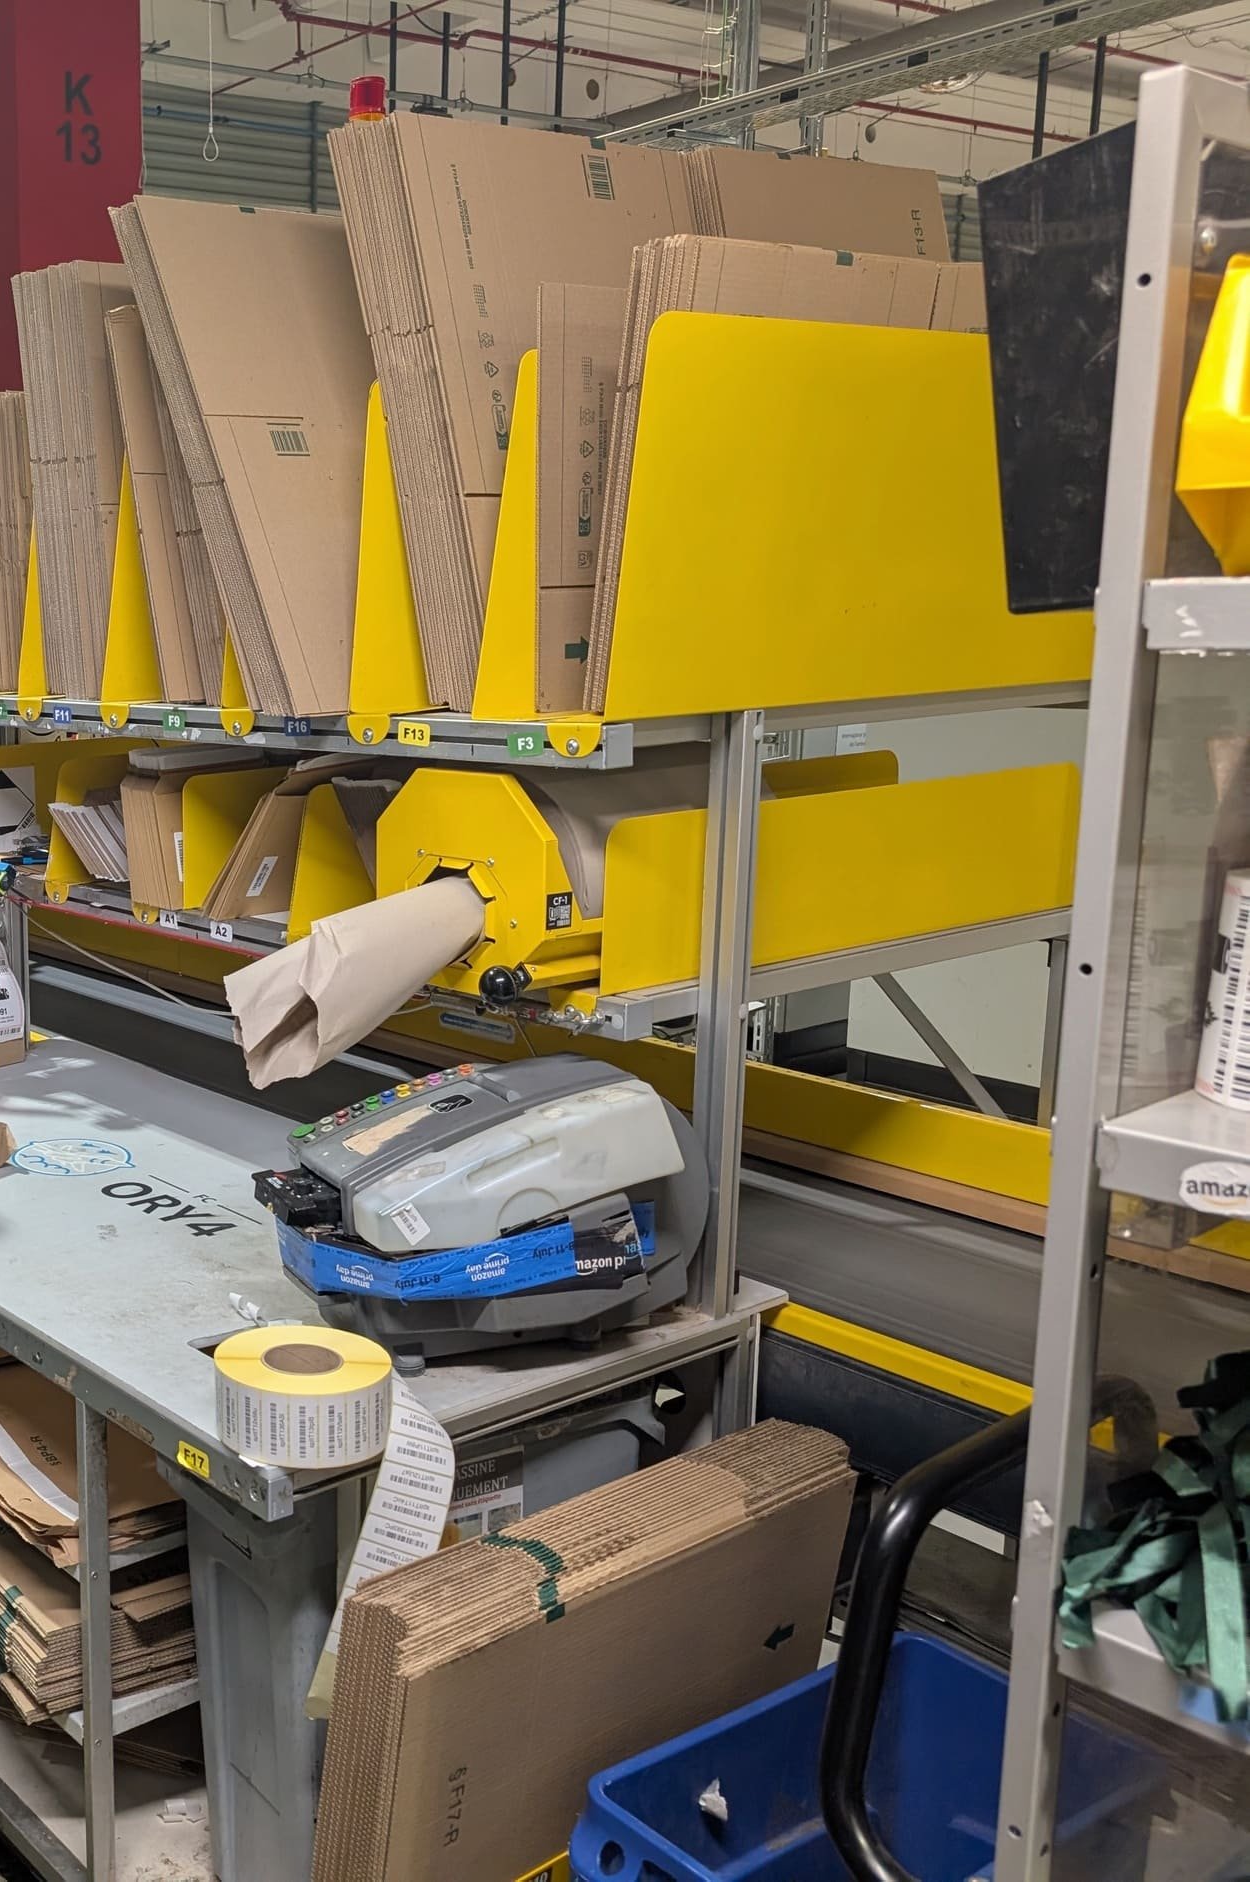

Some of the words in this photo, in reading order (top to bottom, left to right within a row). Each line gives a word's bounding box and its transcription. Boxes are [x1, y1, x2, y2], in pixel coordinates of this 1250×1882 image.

[65, 70, 93, 115] K
[56, 120, 102, 165] 13
[54, 709, 70, 722] F11
[168, 714, 181, 727] F9
[287, 721, 308, 733] F16
[403, 728, 425, 741] F13
[517, 737, 534, 751] F3
[164, 913, 175, 924] A1
[215, 925, 227, 937] A2
[1186, 1179, 1250, 1198] amaz
[192, 1194, 218, 1204] FC
[101, 1181, 238, 1237] ORY4
[465, 1263, 483, 1274] day
[483, 1256, 510, 1270] prime
[340, 1274, 371, 1289] amazon
[350, 1269, 374, 1282] prime
[470, 1267, 506, 1282] amazon
[183, 1447, 205, 1469] F17
[453, 1475, 508, 1500] UEMENT
